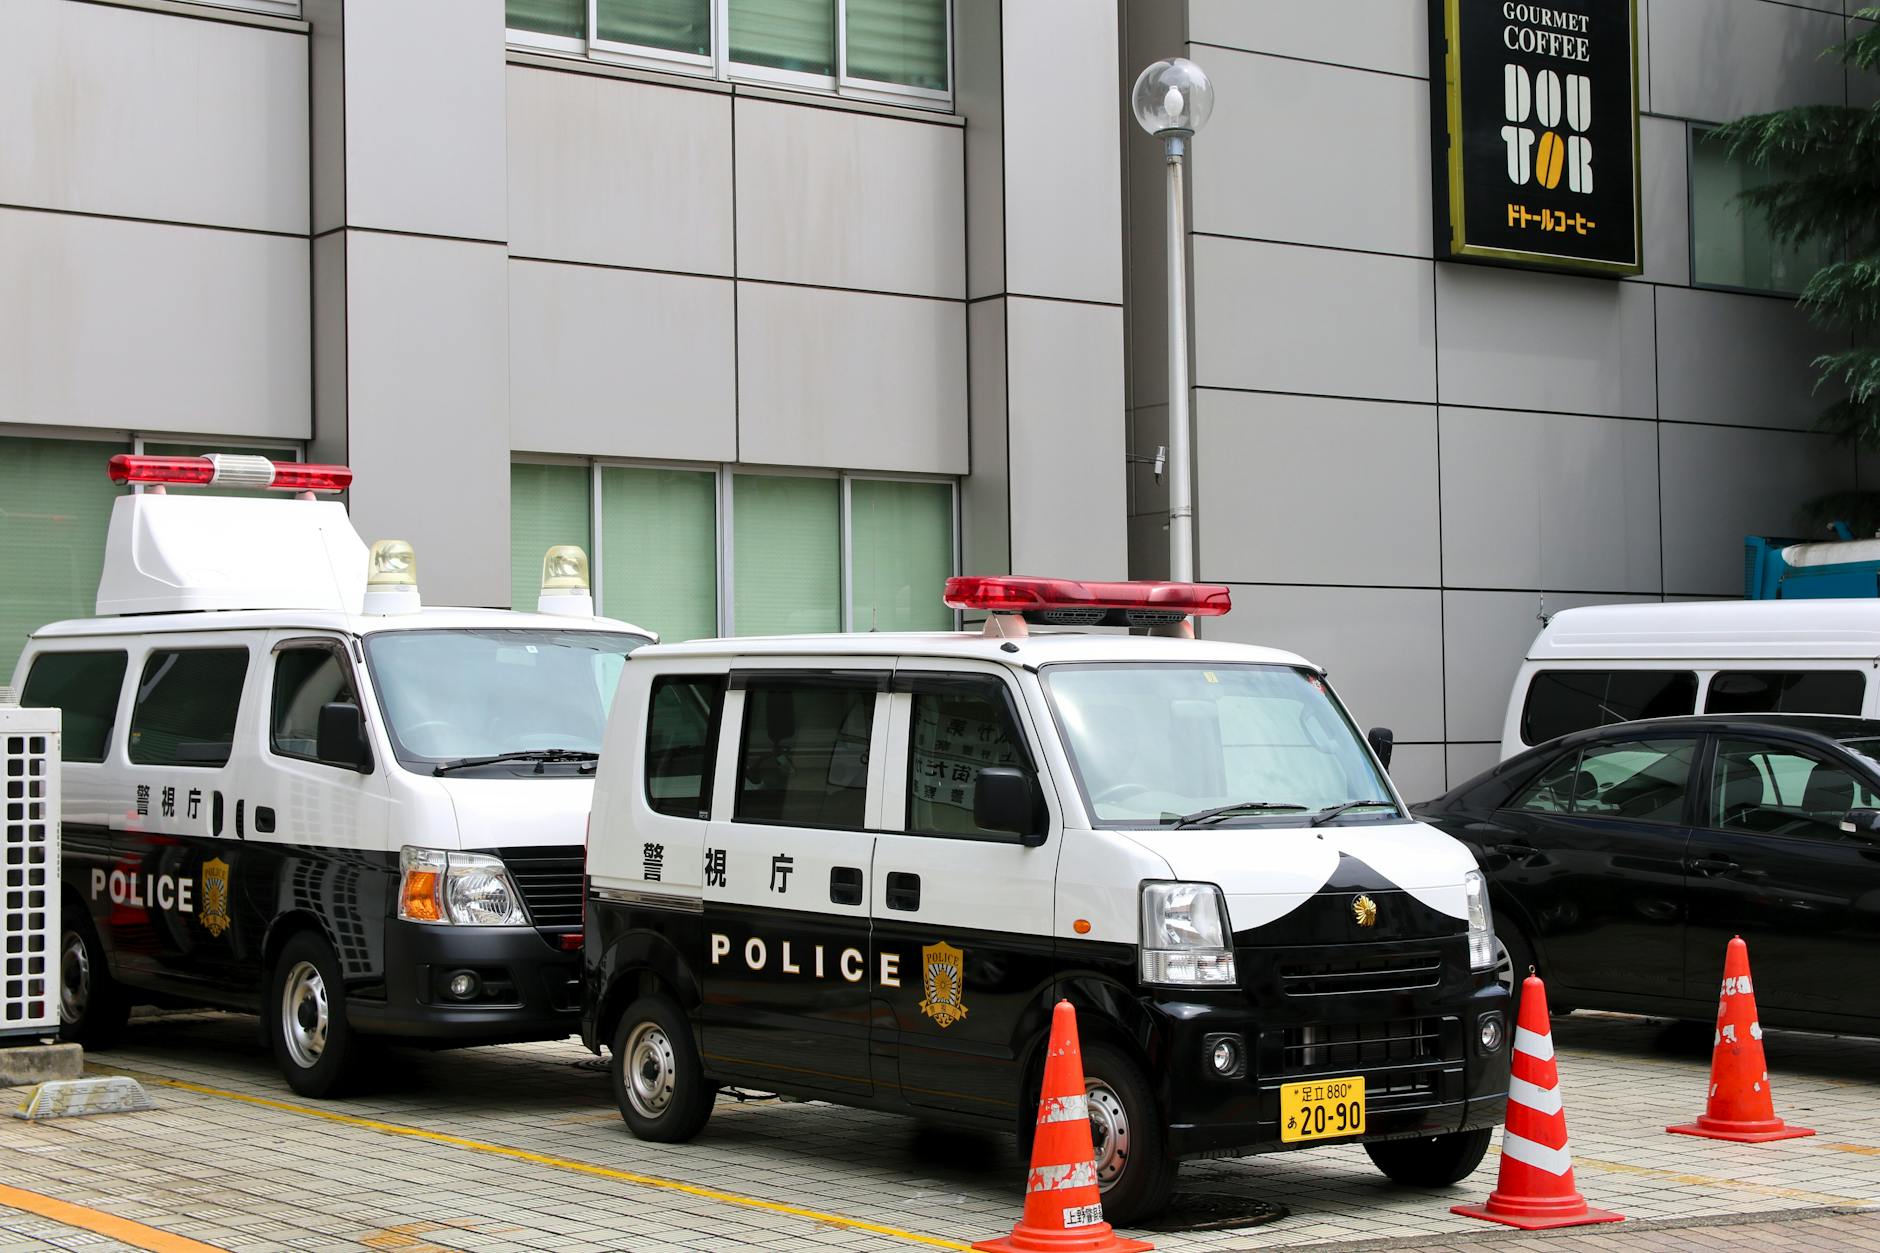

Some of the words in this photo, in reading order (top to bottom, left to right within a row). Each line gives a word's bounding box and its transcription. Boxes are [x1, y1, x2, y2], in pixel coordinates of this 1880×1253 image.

[1503, 2, 1589, 33] GOURMET
[1503, 25, 1590, 62] COFFEE
[1504, 64, 1592, 133] DOU
[1501, 125, 1594, 194] TOR
[1508, 203, 1596, 236] ドトールコーヒー
[136, 784, 202, 819] 警視庁
[642, 842, 794, 894] 警視庁
[91, 868, 194, 912] POLICE
[711, 932, 901, 988] POLICE
[926, 952, 960, 967] POLICE
[1301, 1101, 1361, 1136] 20-90
